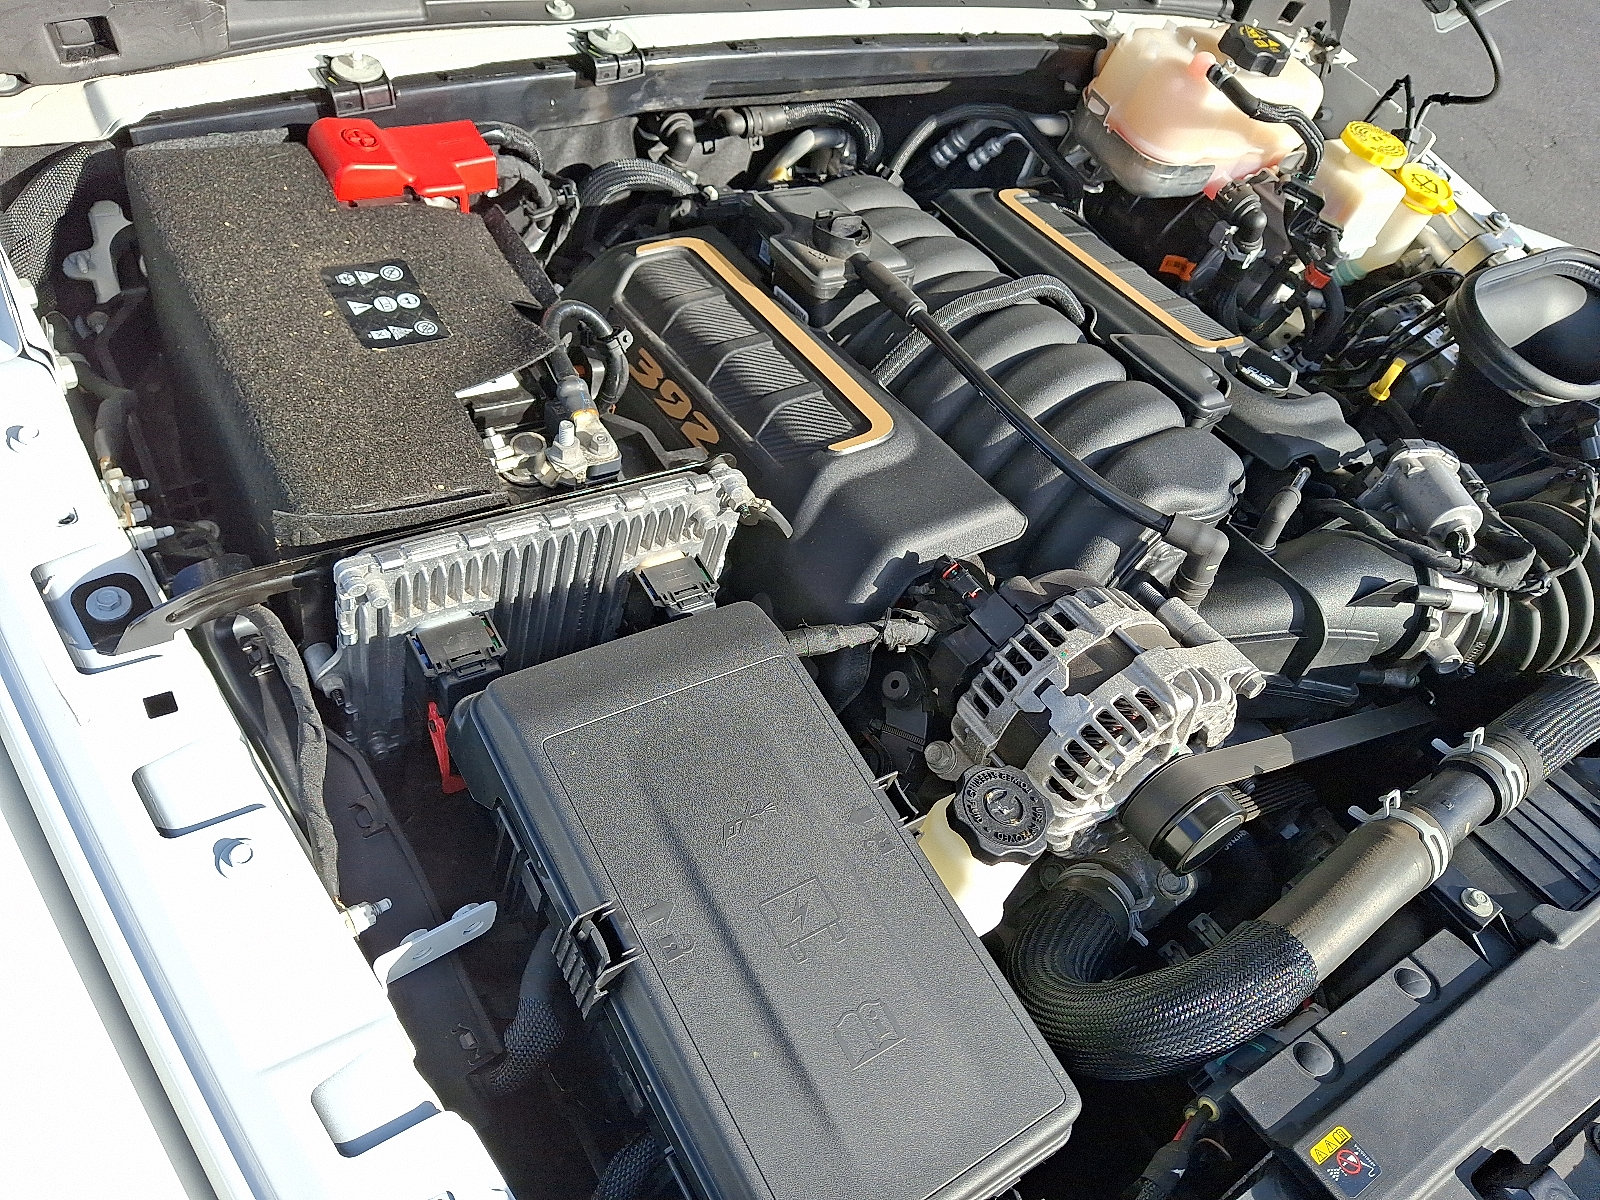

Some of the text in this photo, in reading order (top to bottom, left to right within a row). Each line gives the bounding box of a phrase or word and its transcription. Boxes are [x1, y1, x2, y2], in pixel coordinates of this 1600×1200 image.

[629, 347, 720, 454] 392
[966, 771, 1033, 824] POWER STEERING FLUID
[994, 806, 1044, 842] USE APPROVED
